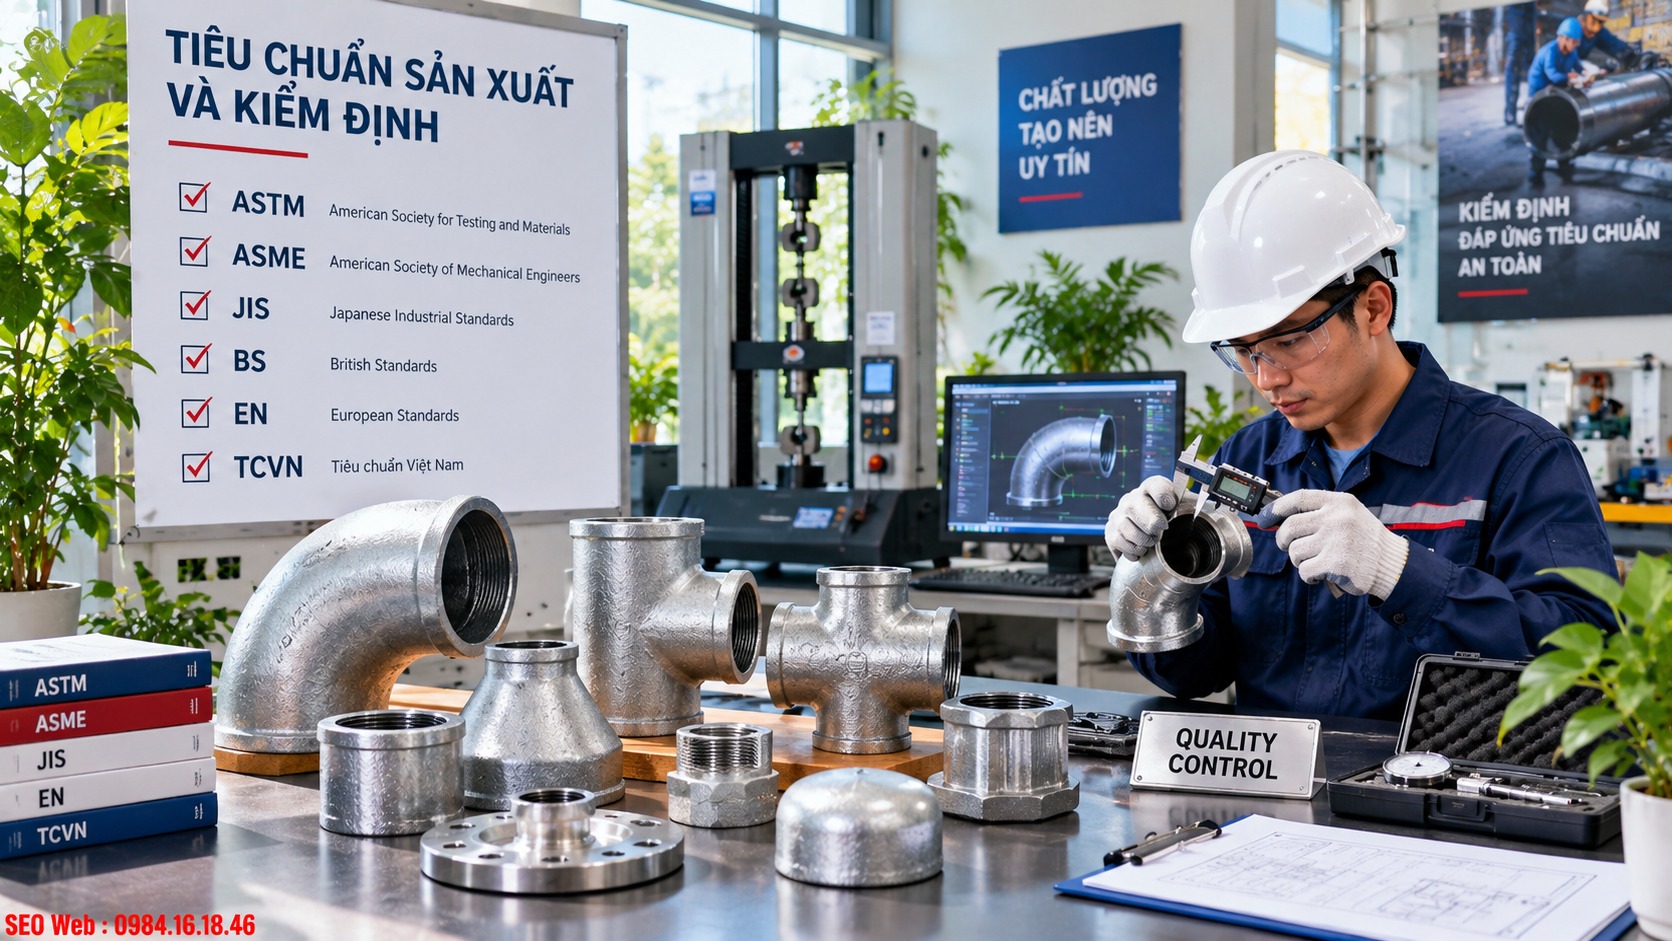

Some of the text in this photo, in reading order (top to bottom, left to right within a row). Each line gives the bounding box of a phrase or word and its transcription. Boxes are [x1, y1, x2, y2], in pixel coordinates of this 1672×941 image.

[165, 25, 575, 108] TIÊU CHUẨN SẢN XUẤT
[1018, 73, 1158, 112] CHẤT LƯỢNG
[166, 76, 439, 146] VÀ KIỂM ĐỊNH
[1018, 110, 1113, 149] TẠO NÊN
[1019, 146, 1090, 180] UY TÍN
[232, 190, 305, 218] ASTM
[1458, 192, 1570, 223] KIỂM ĐỊNH
[329, 203, 571, 236] American Society for Testing and Materials
[1458, 226, 1496, 250] ĐÁP
[1546, 221, 1589, 246] TIÊU
[1591, 214, 1660, 243] CHUẨN
[232, 243, 306, 270] ASME
[1458, 251, 1542, 278] AN TOÀN
[330, 255, 581, 285] American Society of Mechanical Engineers
[232, 297, 270, 320] JIS
[330, 306, 515, 327] Japanese Industrial Standards
[234, 349, 267, 372] BS
[331, 357, 438, 373] British Standards
[235, 402, 268, 425] EN
[331, 408, 460, 425] European Standards
[234, 455, 303, 478] TCVN
[331, 456, 464, 475] Tiêu chuẩn Việt Nam
[34, 673, 87, 698] ASTM
[35, 710, 87, 733] ASME
[1175, 727, 1278, 753] QUALITY
[37, 749, 67, 771] JIS
[1168, 754, 1279, 780] CONTROL
[38, 787, 65, 809] EN
[36, 820, 88, 846] TCVN
